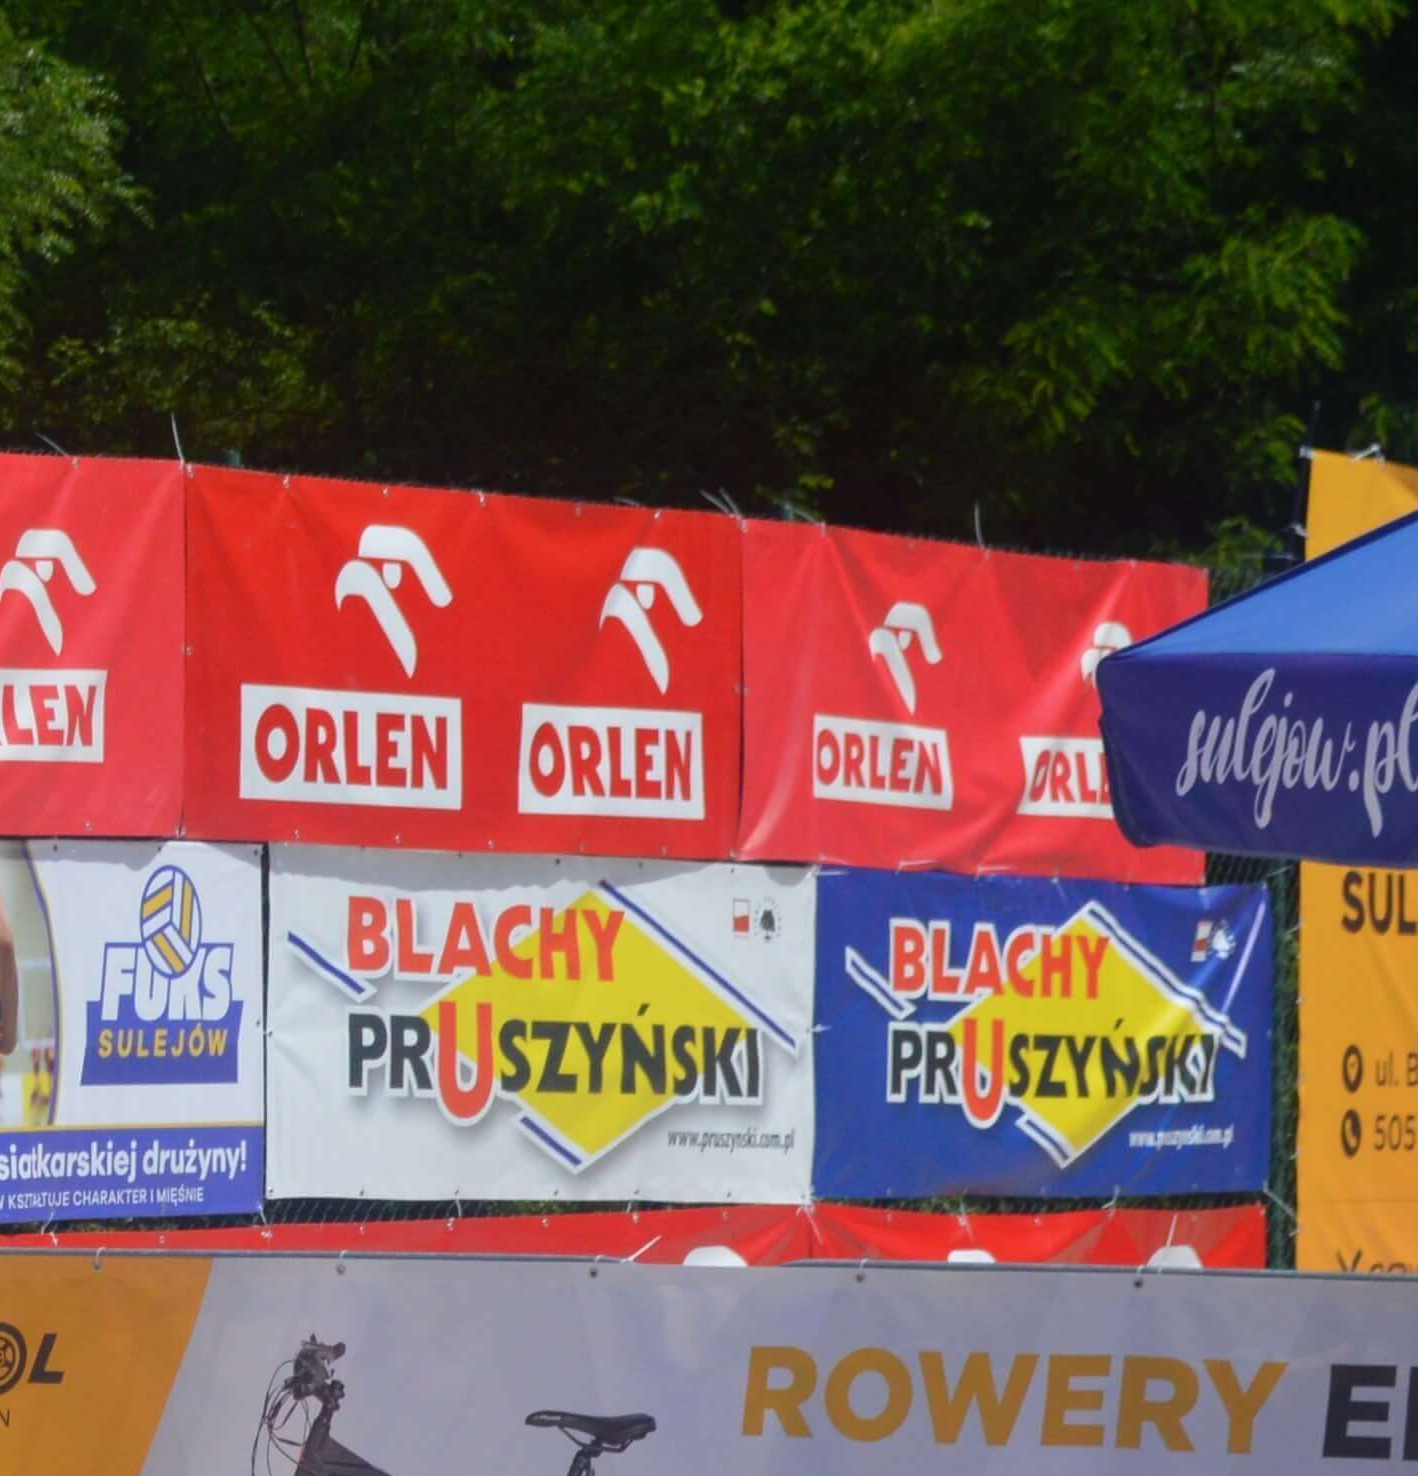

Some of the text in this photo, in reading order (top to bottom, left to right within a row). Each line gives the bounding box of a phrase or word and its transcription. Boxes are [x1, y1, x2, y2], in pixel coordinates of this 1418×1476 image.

[254, 703, 447, 790] ORLEN
[529, 722, 691, 801] ORLEN
[816, 729, 943, 795] ORLEN
[1029, 749, 1111, 805] ORL
[347, 895, 625, 982] BLACHY
[893, 924, 1109, 1000] BLACHY
[103, 945, 233, 1022] FUKS
[98, 1023, 227, 1058] SULEJÓW
[348, 1001, 761, 1120] PRUSZYŃSKI
[890, 1018, 1216, 1123] PRUSZYŃSKI
[72, 1187, 147, 1206] CHARAKTER
[156, 1184, 204, 1207] MIĘŚNIE
[142, 1138, 247, 1180] drużyny!
[741, 1346, 1418, 1460] ROWERY E
